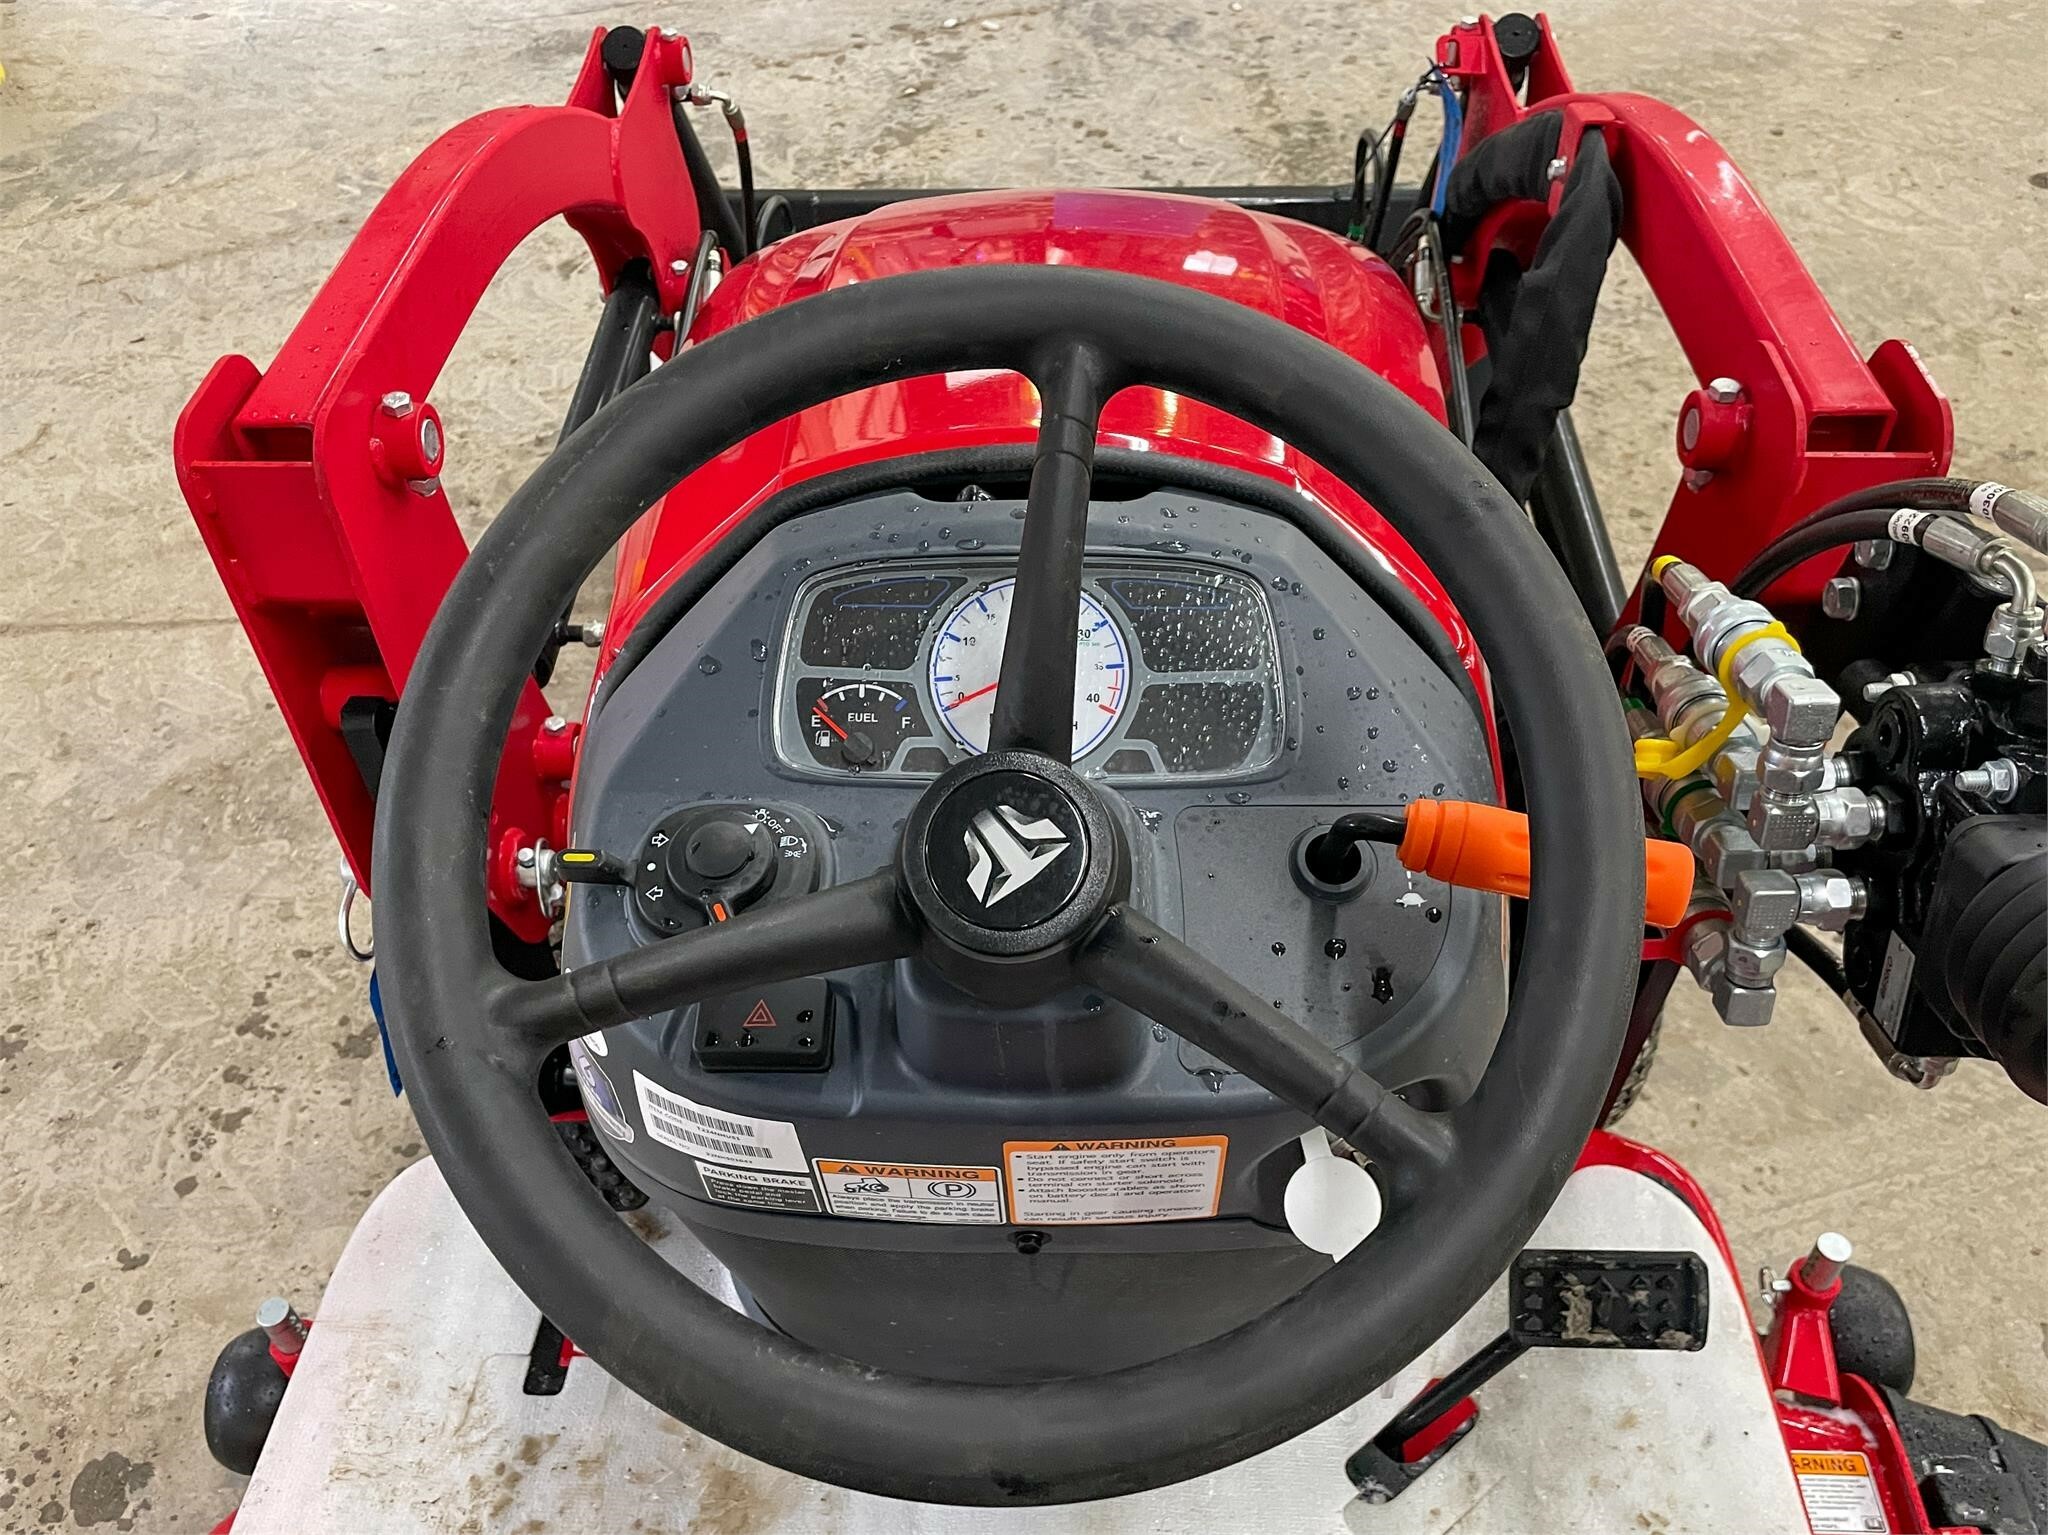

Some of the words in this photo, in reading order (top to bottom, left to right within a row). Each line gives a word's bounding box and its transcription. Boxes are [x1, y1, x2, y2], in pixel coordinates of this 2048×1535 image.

[1078, 629, 1090, 638] 30
[1087, 694, 1099, 702] 40
[812, 715, 821, 727] E
[848, 713, 878, 722] FUEL
[902, 717, 911, 728] F
[768, 819, 785, 833] OFF
[1076, 1140, 1176, 1150] WARNING
[704, 1167, 757, 1181] PARKING
[763, 1177, 806, 1186] BRAKE
[864, 1166, 979, 1179] WARNING
[1792, 1458, 1856, 1471] ARNING
